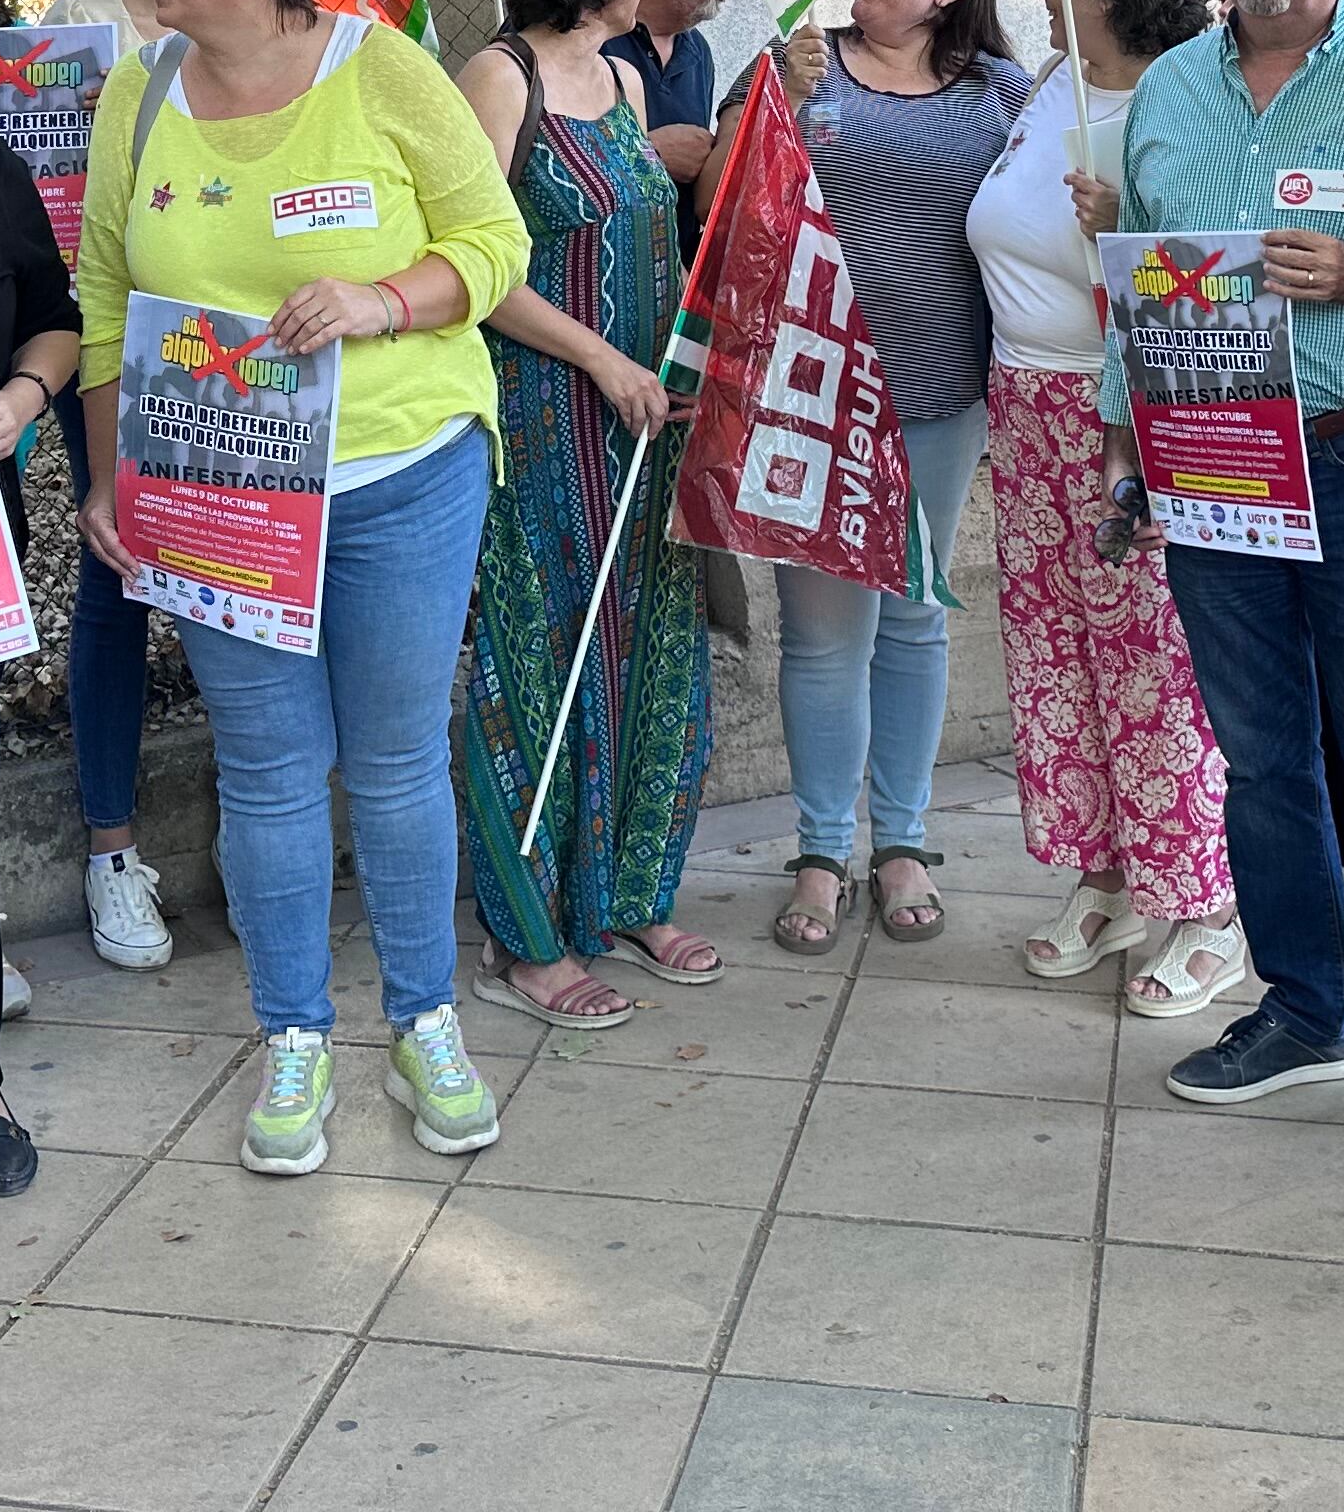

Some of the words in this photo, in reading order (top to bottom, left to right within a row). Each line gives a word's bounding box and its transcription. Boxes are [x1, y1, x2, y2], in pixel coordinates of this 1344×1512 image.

[11, 112, 78, 130] RETENER
[1284, 178, 1310, 191] UGT
[276, 188, 353, 217] CCOO
[308, 212, 345, 227] Jaén
[1174, 330, 1191, 349] DE
[1193, 331, 1251, 351] RETENER
[1255, 331, 1272, 351] EL
[1144, 349, 1175, 367] BONO
[1176, 351, 1193, 369] DE
[140, 395, 195, 420] ¡BASTA
[198, 406, 217, 425] DE
[220, 411, 290, 439] RETENER
[293, 422, 310, 443] EL
[1192, 410, 1197, 419] 9
[1198, 411, 1210, 421] DE
[1212, 412, 1252, 422] OCTUBRE
[150, 418, 191, 443] BONO
[194, 428, 214, 448] DE
[216, 432, 299, 464] ALQUILER!
[171, 484, 197, 498] LUNES
[199, 490, 205, 500] 9
[207, 493, 220, 504] DE
[222, 496, 269, 513] OCTUBRE
[1247, 513, 1267, 524] UGT
[240, 603, 263, 617] UGT
